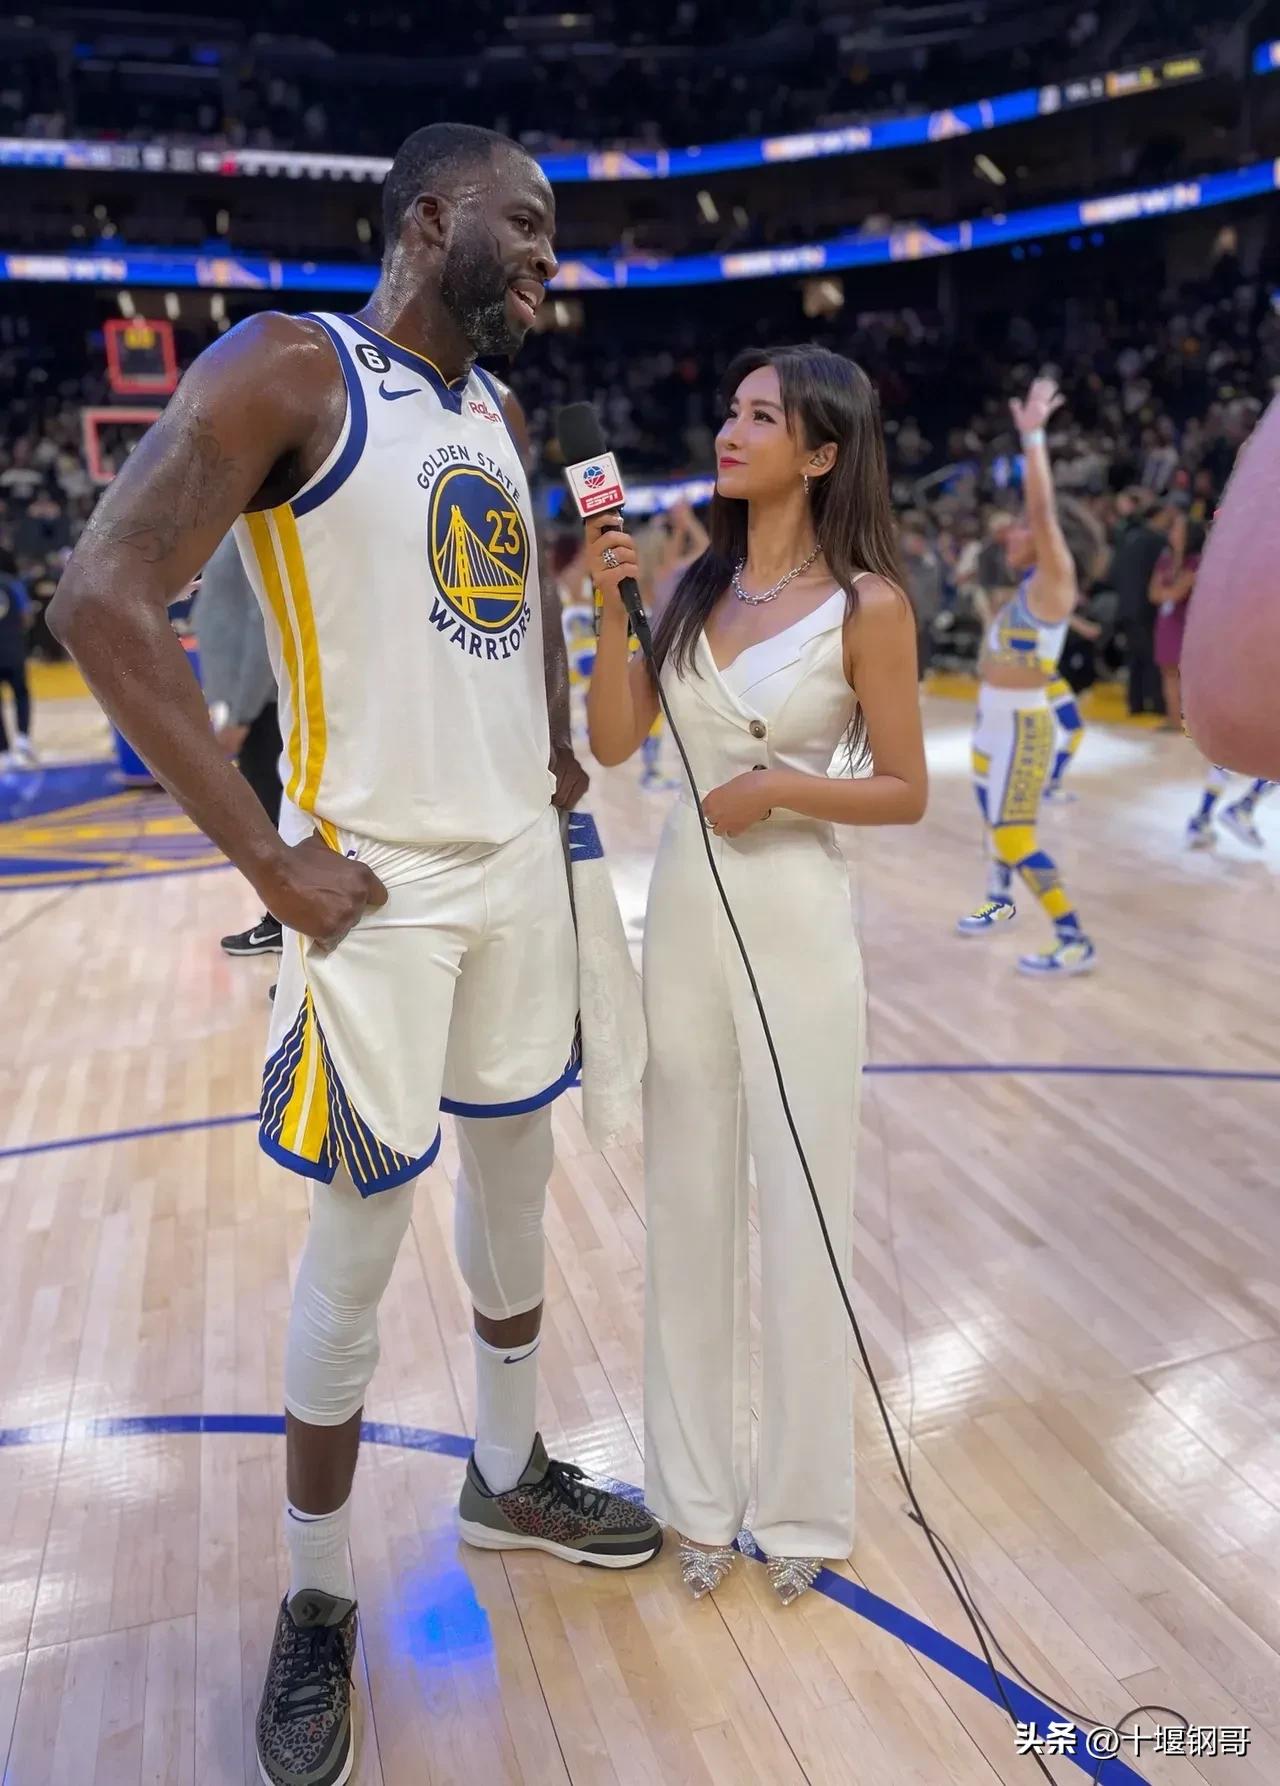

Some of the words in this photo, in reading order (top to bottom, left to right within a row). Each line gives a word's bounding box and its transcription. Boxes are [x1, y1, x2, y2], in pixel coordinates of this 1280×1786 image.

[362, 348, 385, 369] 6
[417, 445, 470, 489] GOLDEN
[478, 452, 521, 503] STATE
[586, 489, 618, 509] ESPN
[486, 509, 520, 555] 23
[428, 597, 531, 660] WARRIORS
